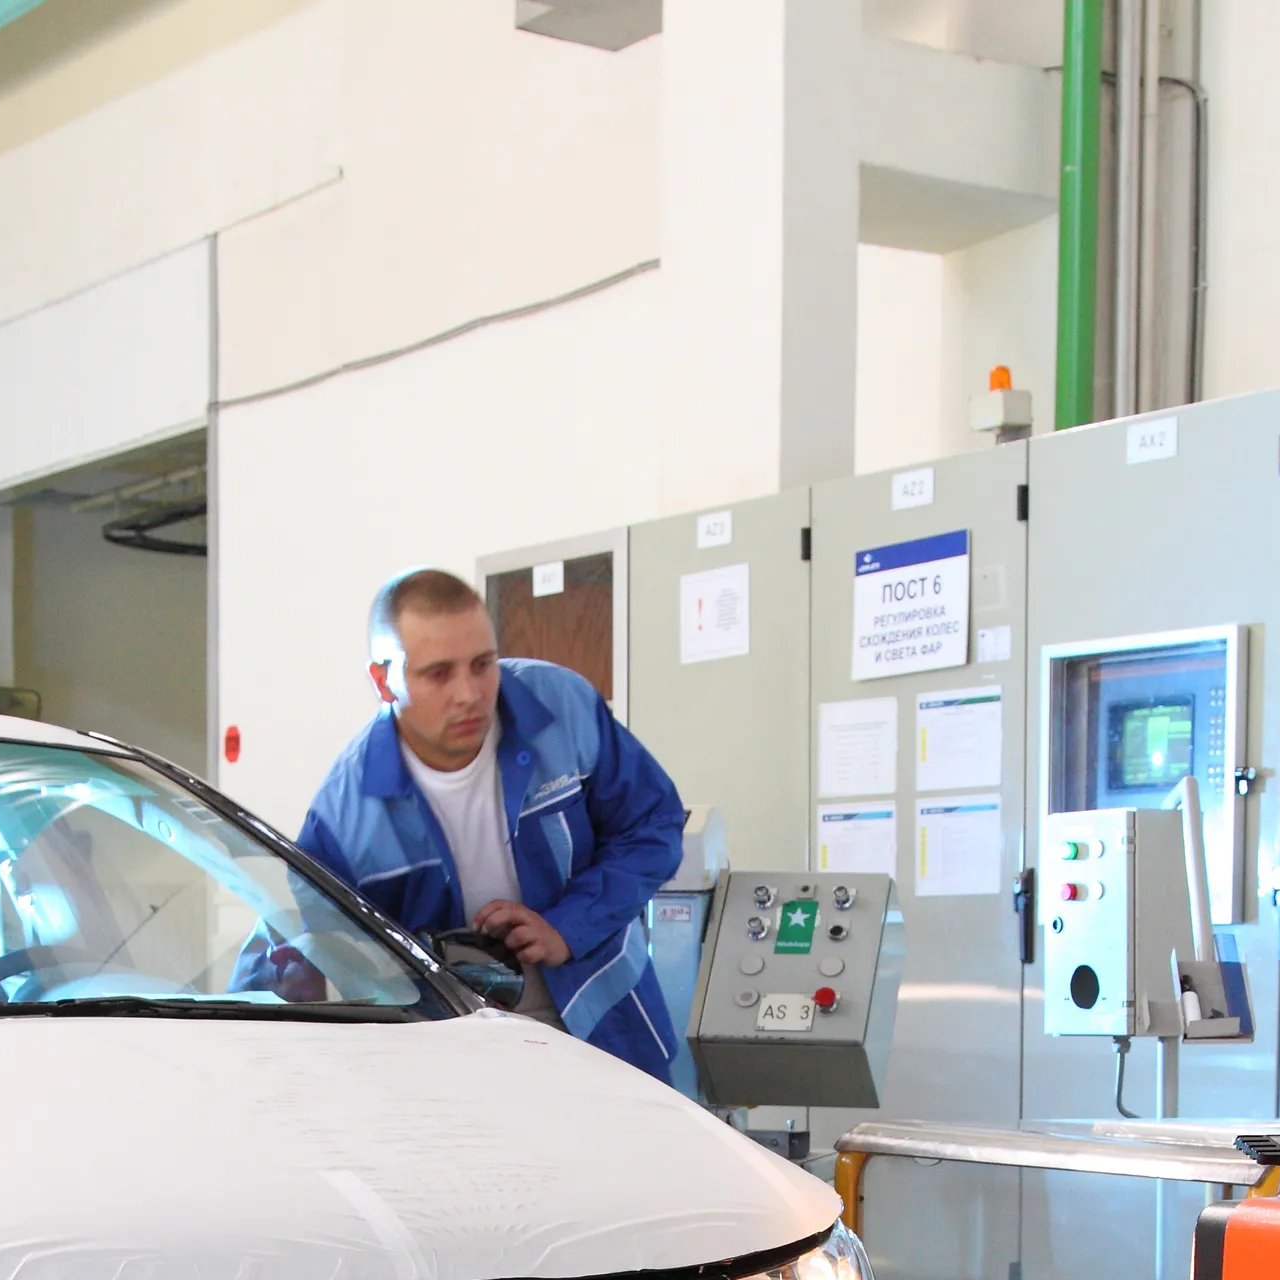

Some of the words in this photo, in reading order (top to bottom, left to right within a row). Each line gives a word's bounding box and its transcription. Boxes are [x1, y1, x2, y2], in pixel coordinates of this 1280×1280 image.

[1138, 431, 1166, 450] AX2
[881, 577, 928, 604] ПОСТ
[933, 575, 942, 595] 6
[873, 605, 947, 627] РЕГУЛИРОВКА
[859, 626, 924, 648] СХОЖДЕНИЯ
[926, 620, 960, 637] КОЛЕС
[874, 652, 883, 664] И
[884, 646, 918, 662] СВЕТА
[921, 641, 943, 657] ФАР
[762, 1004, 787, 1020] AS
[800, 1004, 810, 1020] 3
